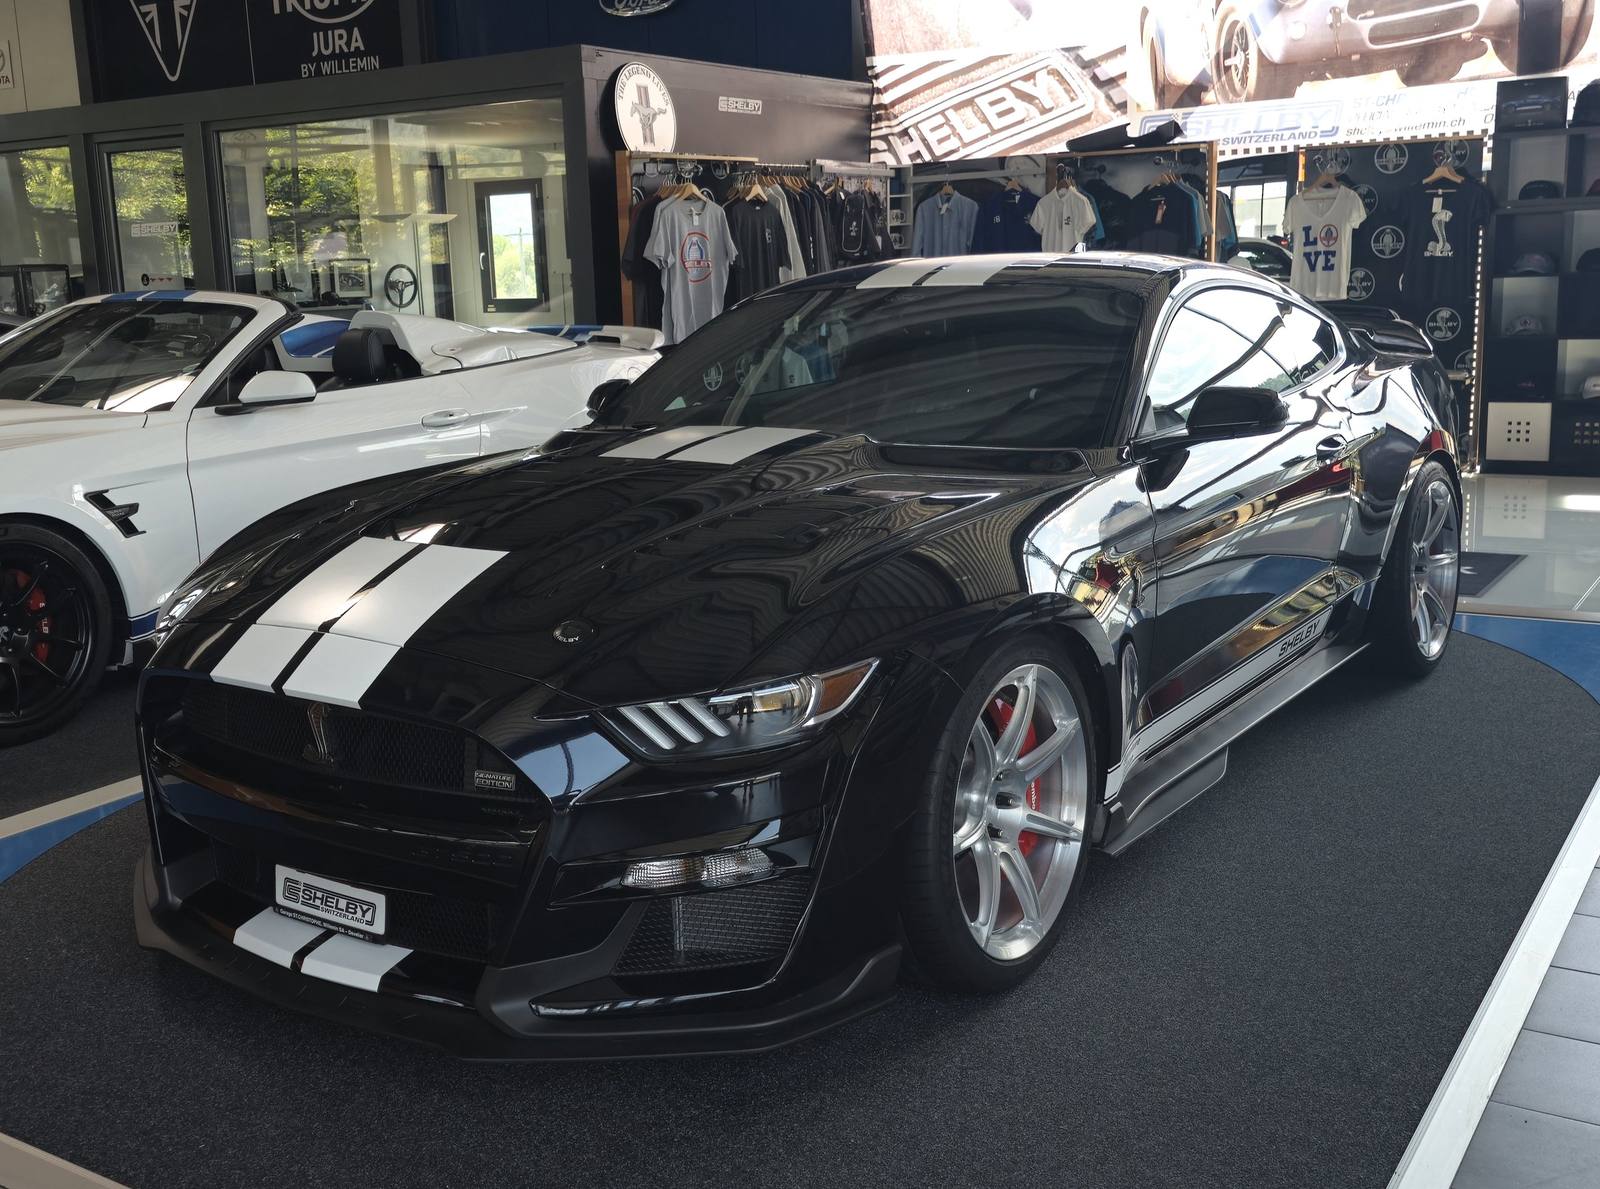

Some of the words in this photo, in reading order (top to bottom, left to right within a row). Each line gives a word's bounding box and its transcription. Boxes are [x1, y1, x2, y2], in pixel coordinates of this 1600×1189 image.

[312, 27, 365, 57] JURA
[301, 63, 317, 78] BY
[320, 56, 380, 76] WILLEMIN
[618, 79, 627, 101] THE
[624, 66, 651, 81] LEGEND
[652, 77, 669, 106] LIVES
[727, 100, 761, 112] SHELBY
[1222, 131, 1318, 146] SWITZERLAND
[140, 223, 177, 235] SHELBY
[1278, 620, 1320, 657] SHELBY
[475, 771, 511, 781] SIGNATURE
[476, 778, 513, 789] EDITION
[301, 888, 371, 918] SHELBY
[320, 907, 364, 924] SWITZERLAND
